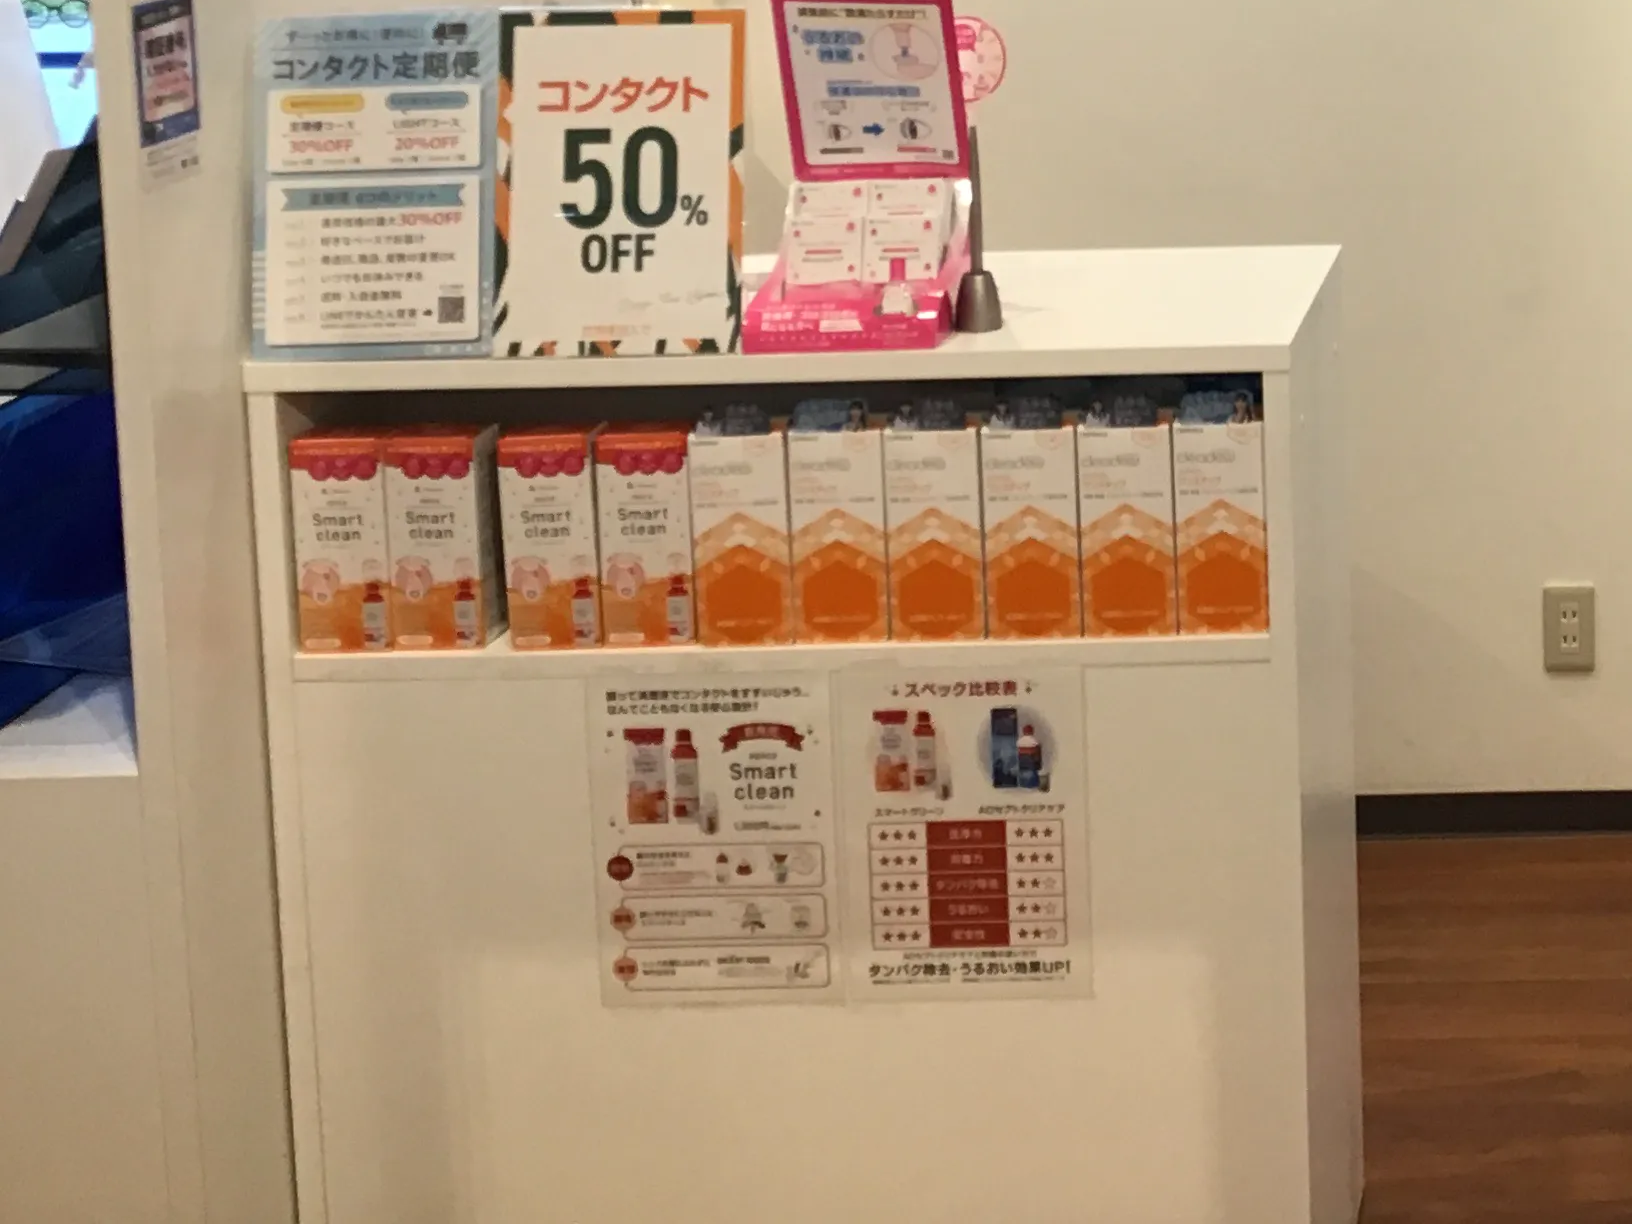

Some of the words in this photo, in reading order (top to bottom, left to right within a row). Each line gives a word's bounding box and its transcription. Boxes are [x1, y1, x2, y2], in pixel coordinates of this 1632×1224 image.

[272, 50, 481, 82] コンタクト定期便
[537, 77, 710, 114] コンタクト
[559, 125, 709, 229] 50%
[580, 233, 657, 274] OFF
[312, 512, 365, 527] Smart
[405, 510, 456, 525] Smart
[519, 509, 572, 524] Smart
[616, 507, 669, 522] Smart
[315, 528, 362, 542] clean
[408, 526, 454, 540] clean
[523, 525, 571, 539] clean
[620, 522, 668, 536] clean
[904, 680, 1018, 698] スペック比較表
[729, 762, 798, 781] Smart
[734, 783, 795, 801] clean
